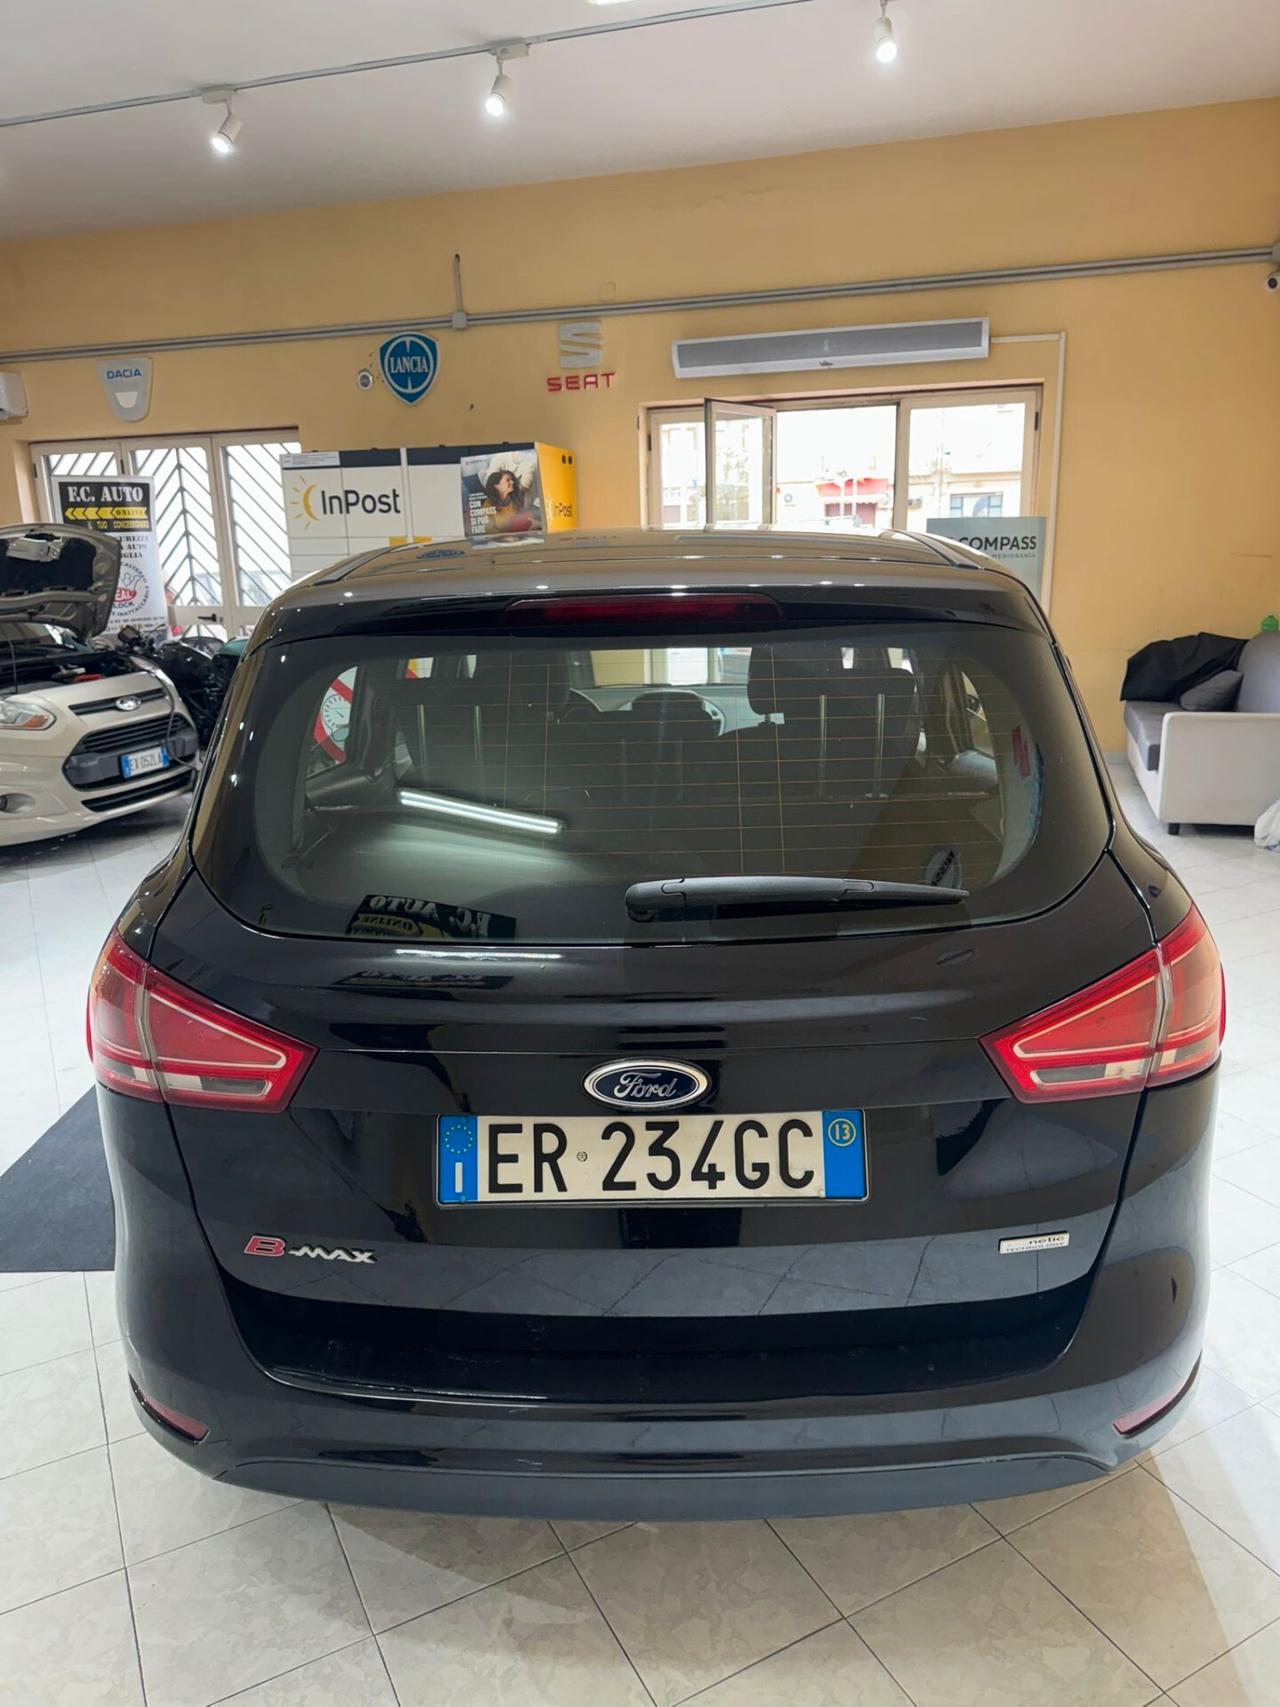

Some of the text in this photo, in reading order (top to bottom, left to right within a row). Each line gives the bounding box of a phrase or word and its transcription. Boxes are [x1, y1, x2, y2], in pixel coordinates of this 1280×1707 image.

[106, 368, 142, 380] DACIA
[390, 355, 429, 374] LANCIA
[546, 372, 616, 392] SEAT
[67, 486, 144, 503] F.C. AUTO
[321, 488, 401, 515] InPost
[614, 1072, 677, 1098] Ford
[835, 1124, 850, 1140] 13
[488, 1119, 814, 1194] ER 234GC
